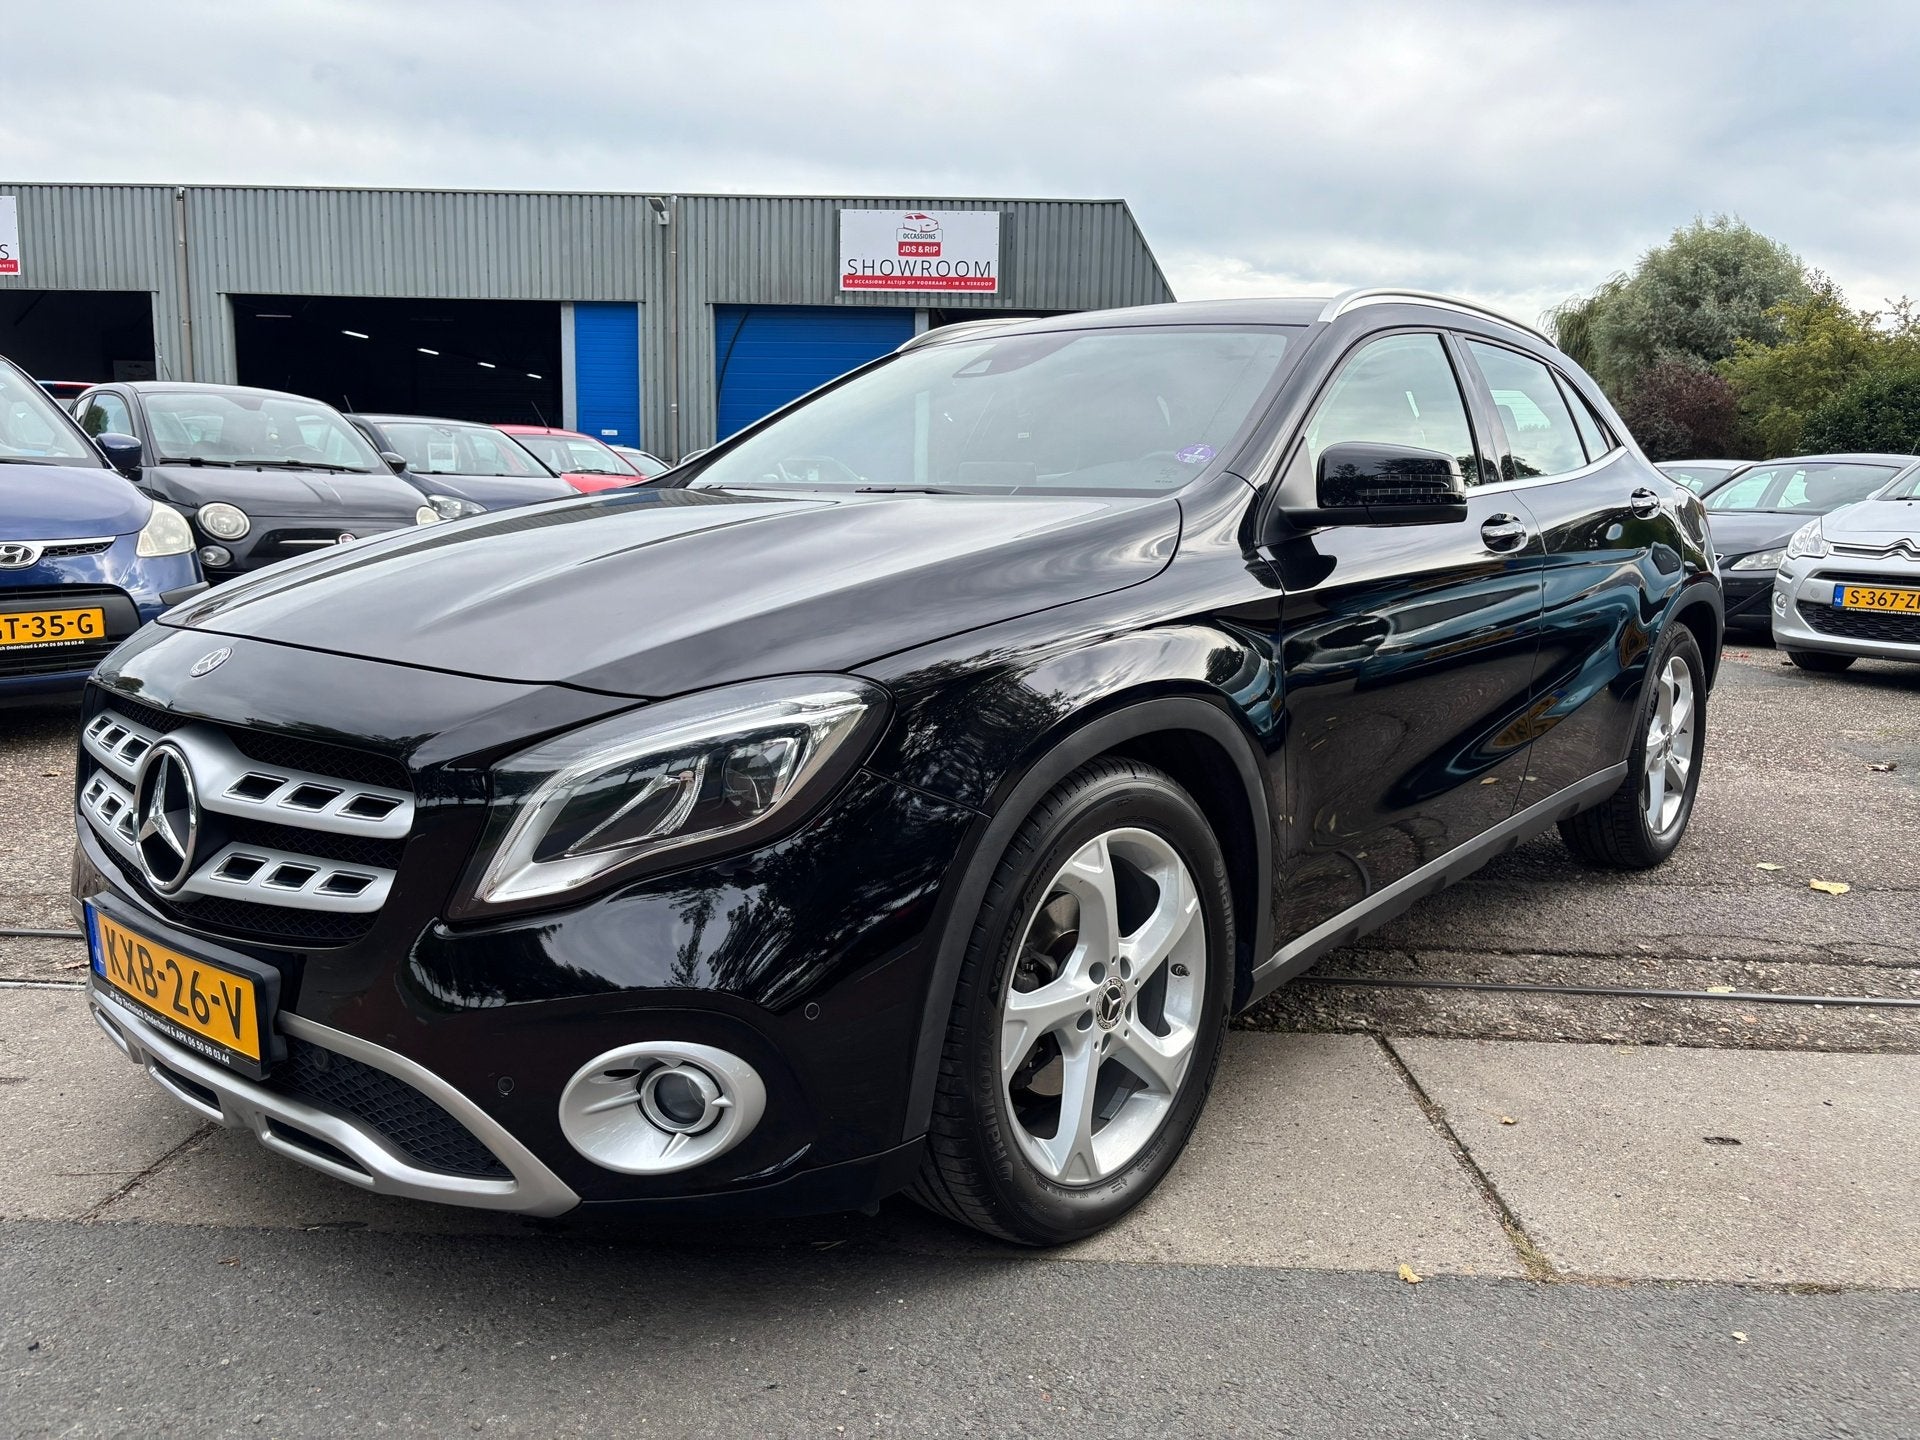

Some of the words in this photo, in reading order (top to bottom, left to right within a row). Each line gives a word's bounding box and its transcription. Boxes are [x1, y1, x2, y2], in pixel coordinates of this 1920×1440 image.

[903, 232, 936, 240] OCCASSIONS
[900, 245, 917, 253] JDS
[918, 245, 924, 253] &
[924, 245, 939, 254] RIP
[847, 258, 991, 278] SHOWROOM
[104, 925, 242, 1040] KXB-26-V
[175, 1030, 188, 1043] APK
